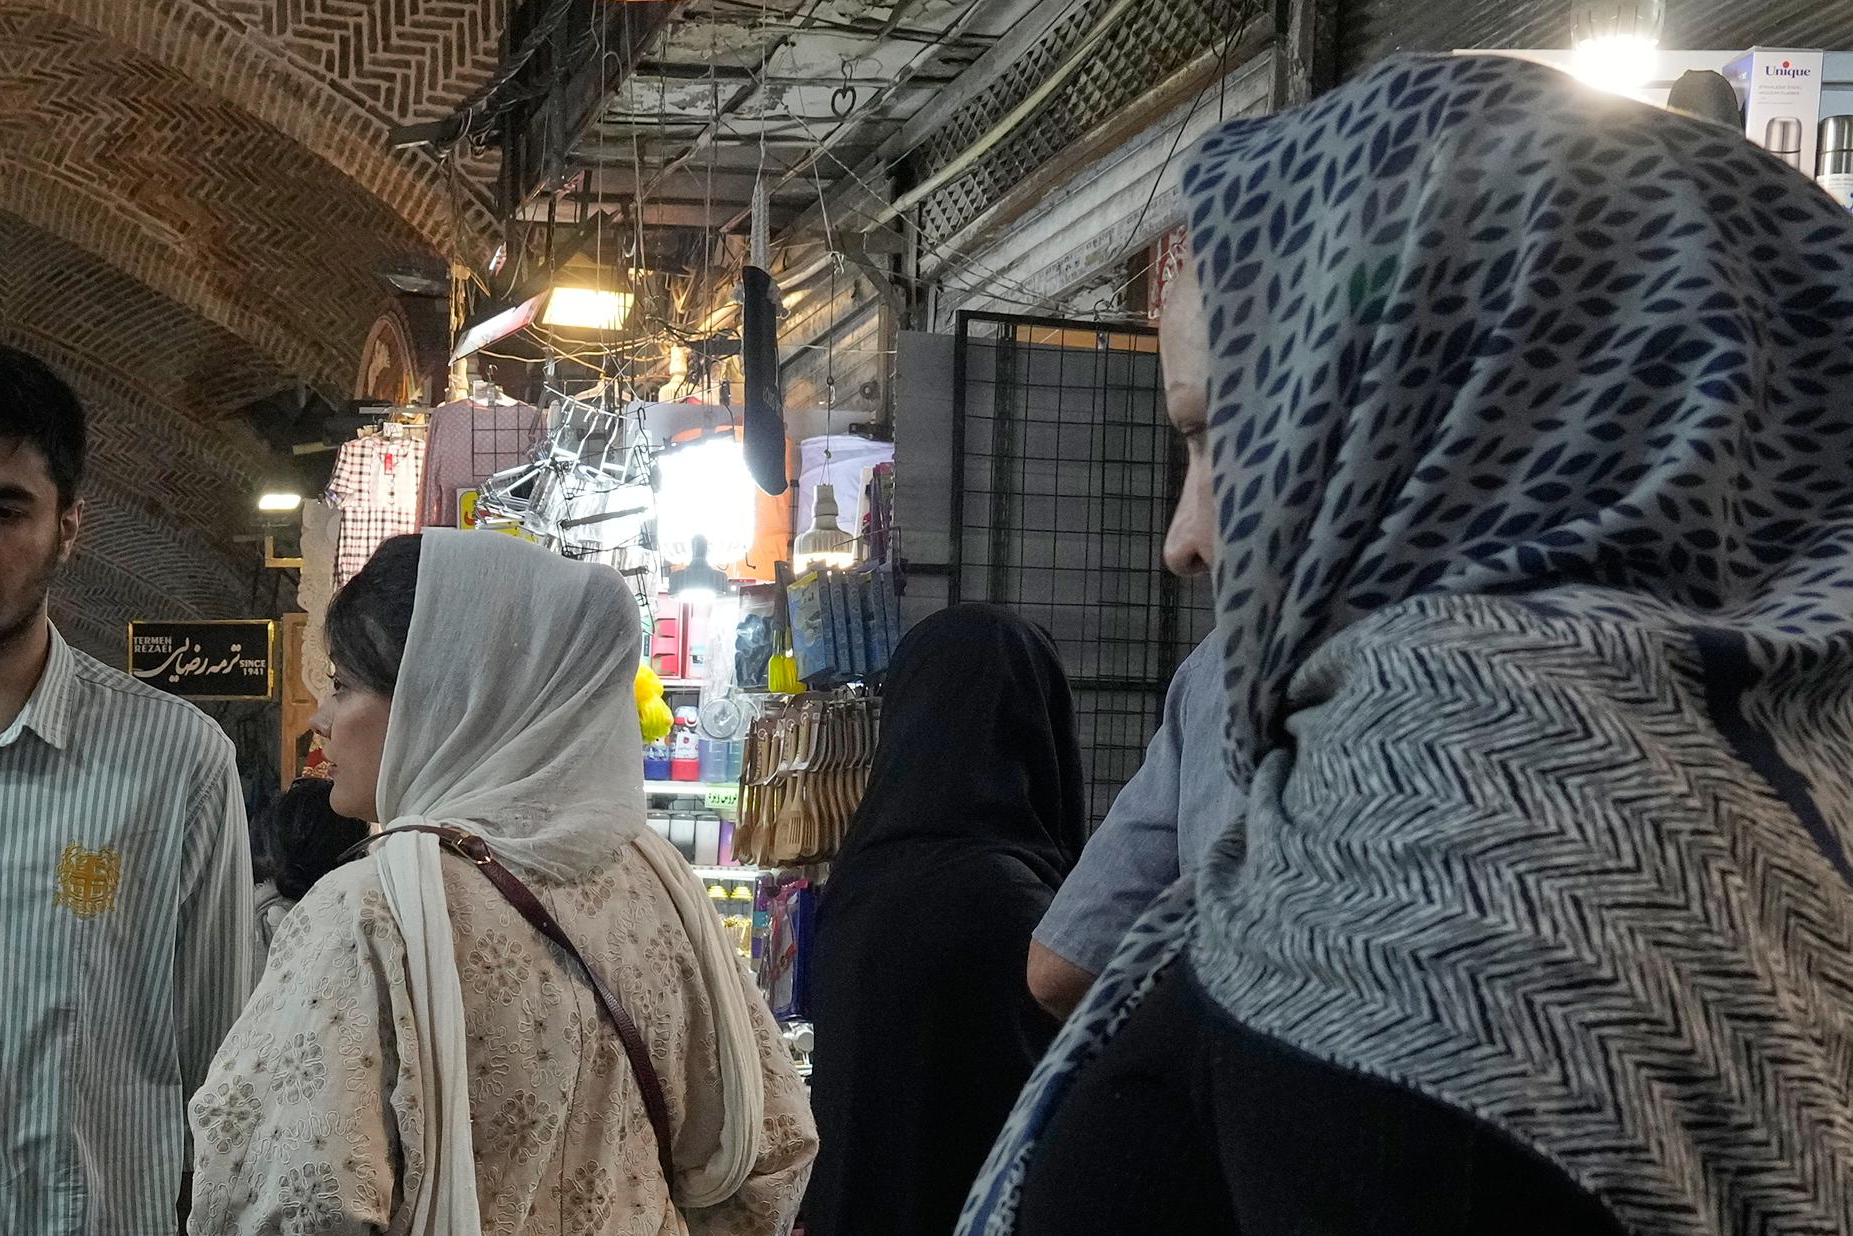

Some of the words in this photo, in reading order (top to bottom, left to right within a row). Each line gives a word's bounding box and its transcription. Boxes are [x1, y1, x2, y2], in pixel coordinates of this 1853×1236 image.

[1765, 60, 1811, 79] Unique
[133, 636, 172, 645] TERMEH
[134, 645, 172, 653] REZAEI
[205, 643, 242, 676] ترمه
[239, 659, 266, 668] SINCE
[243, 668, 264, 676] 1941
